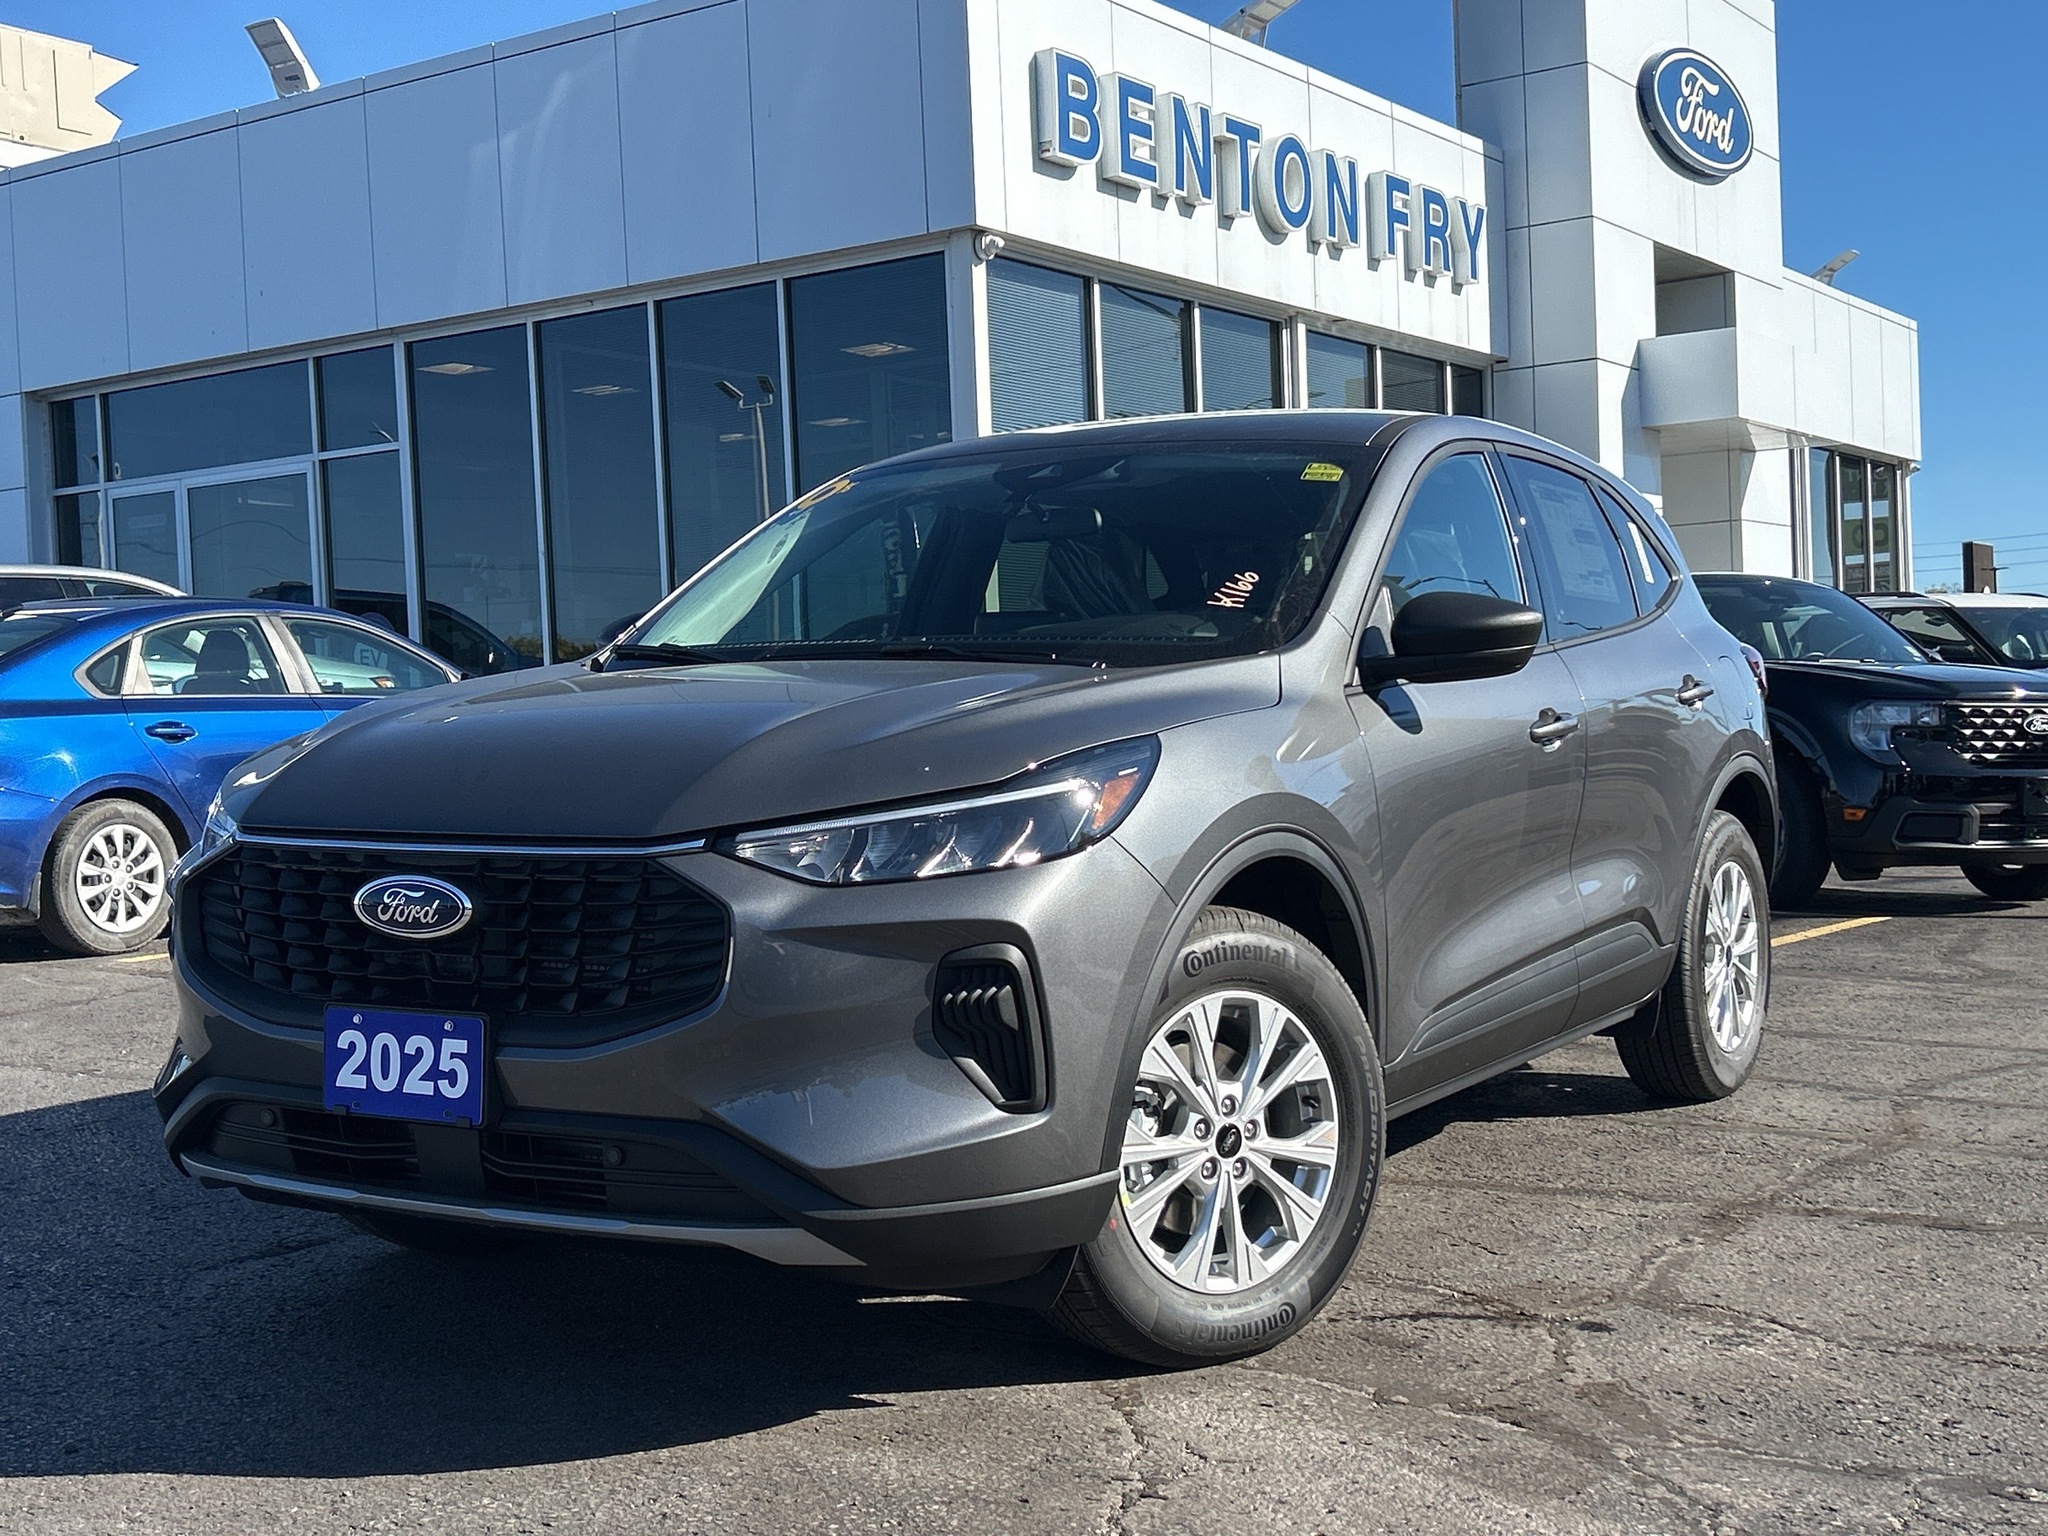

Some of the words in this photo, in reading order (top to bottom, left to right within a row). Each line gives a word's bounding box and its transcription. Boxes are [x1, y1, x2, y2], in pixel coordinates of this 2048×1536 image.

[1675, 65, 1735, 155] Ford
[1040, 49, 1360, 248] BENTON
[1374, 172, 1488, 285] FRY
[1206, 571, 1260, 608] K166
[359, 648, 383, 668] EV
[377, 887, 440, 925] Ford
[1183, 940, 1288, 978] Continental
[335, 1028, 470, 1100] 2025
[1188, 1302, 1297, 1345] Continental
